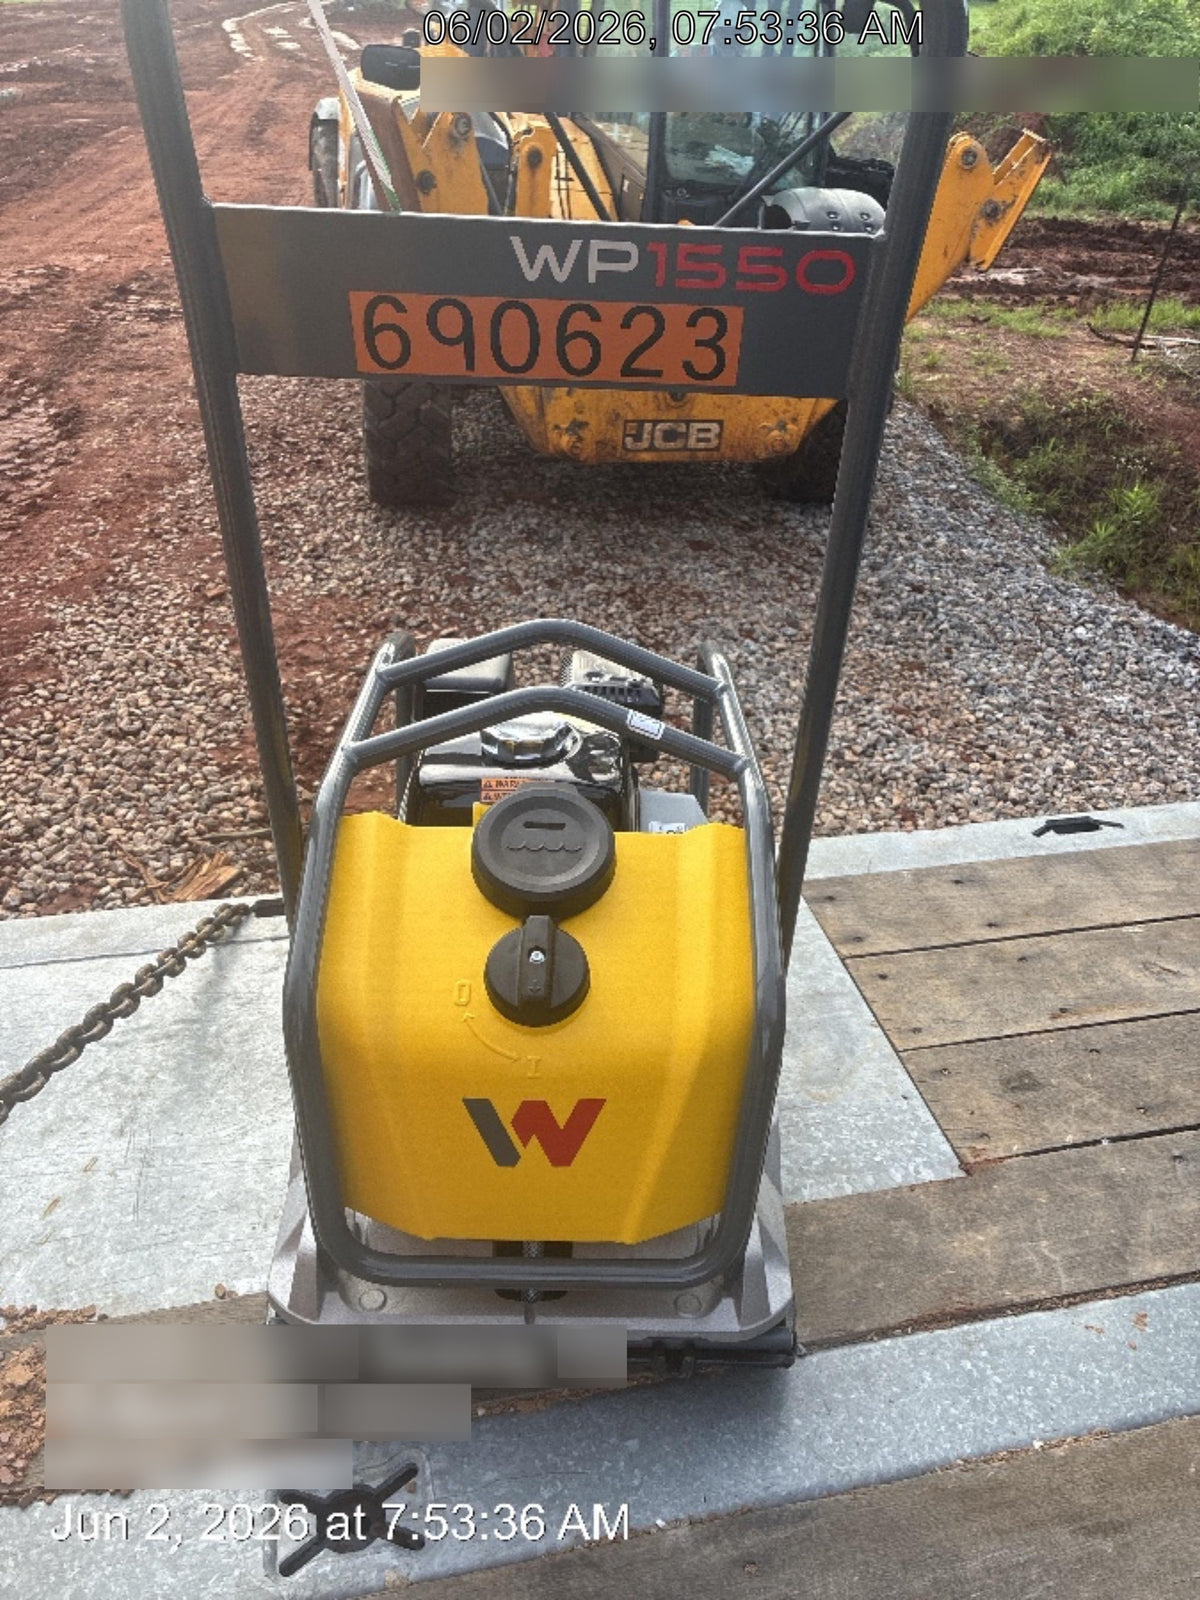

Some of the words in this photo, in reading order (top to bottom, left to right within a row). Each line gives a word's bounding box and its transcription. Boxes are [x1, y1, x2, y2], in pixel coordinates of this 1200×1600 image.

[509, 236, 856, 294] WP1550
[363, 295, 728, 381] 690623
[624, 422, 721, 450] JCB
